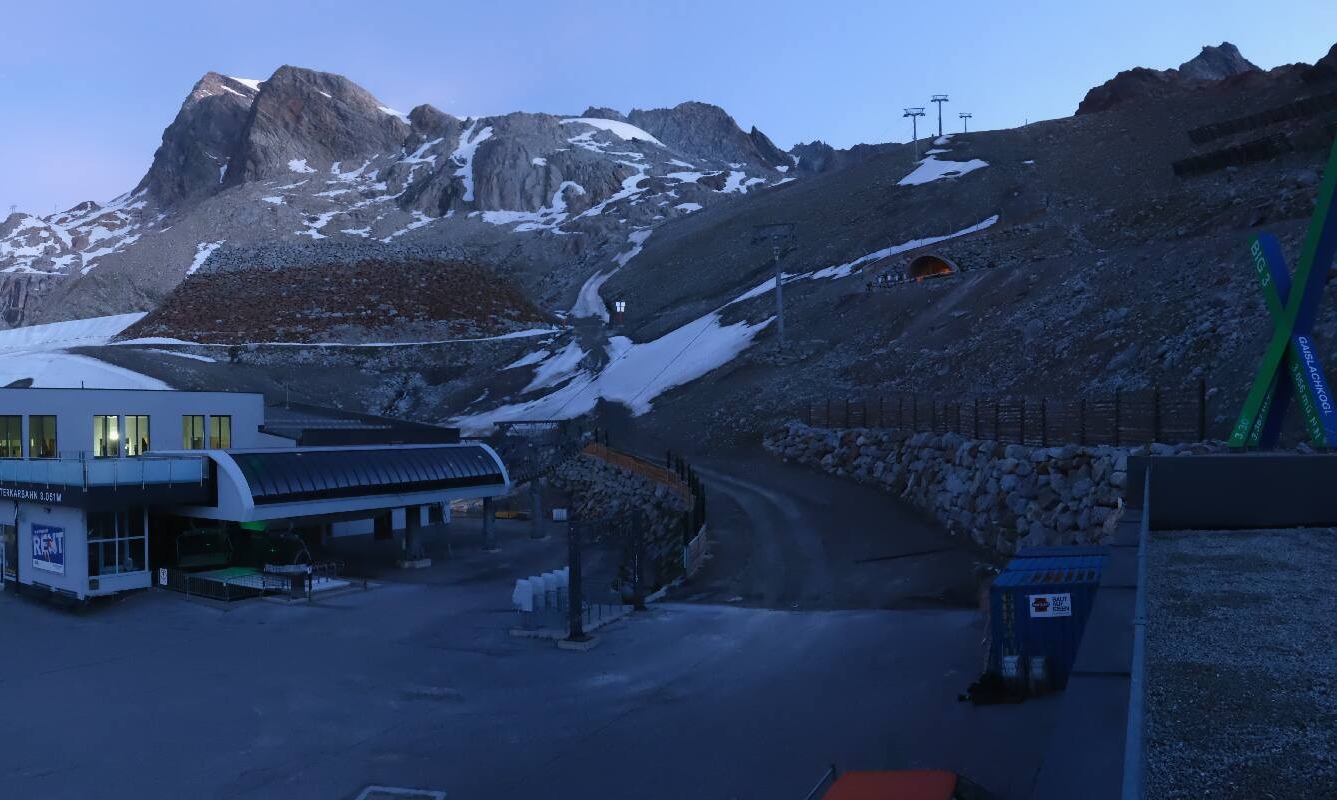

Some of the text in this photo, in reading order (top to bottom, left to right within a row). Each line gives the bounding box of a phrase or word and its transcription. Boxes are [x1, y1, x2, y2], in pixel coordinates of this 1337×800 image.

[1250, 239, 1271, 287] BIG 3
[1297, 336, 1333, 416] GAISLACHKOGL
[33, 532, 64, 556] RENT
